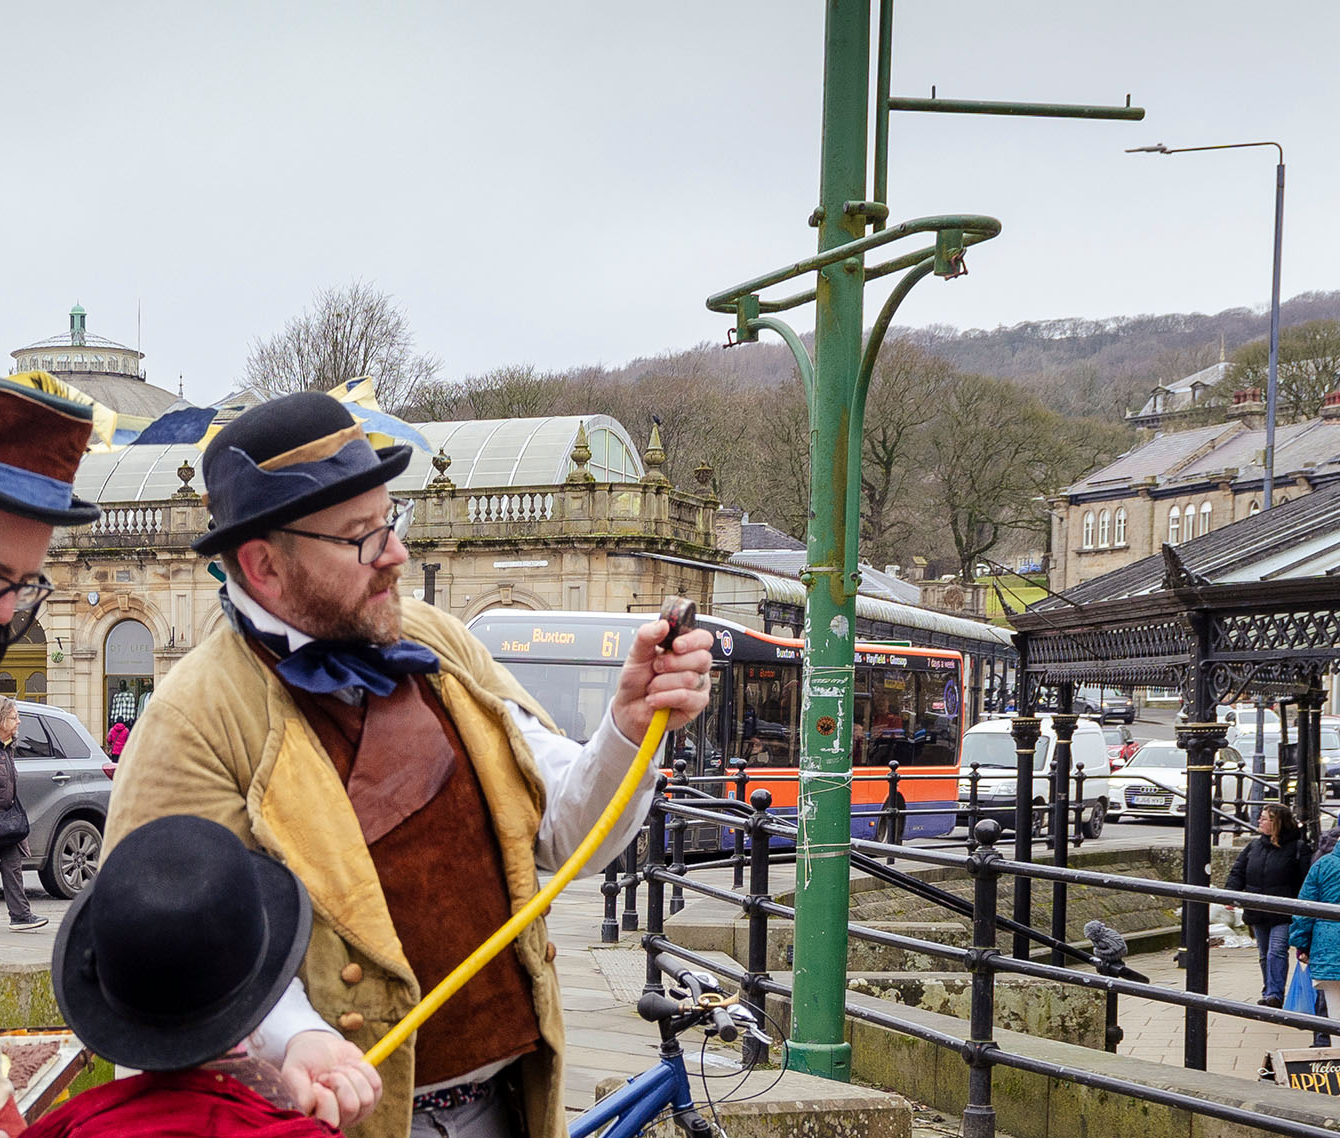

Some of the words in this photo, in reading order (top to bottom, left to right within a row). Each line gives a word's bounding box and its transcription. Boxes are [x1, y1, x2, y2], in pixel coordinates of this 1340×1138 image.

[512, 641, 531, 652] End
[532, 628, 575, 644] Buxton
[601, 631, 620, 657] 61
[776, 647, 796, 659] Buxton
[866, 653, 886, 666] Hayfield
[931, 658, 941, 669] days
